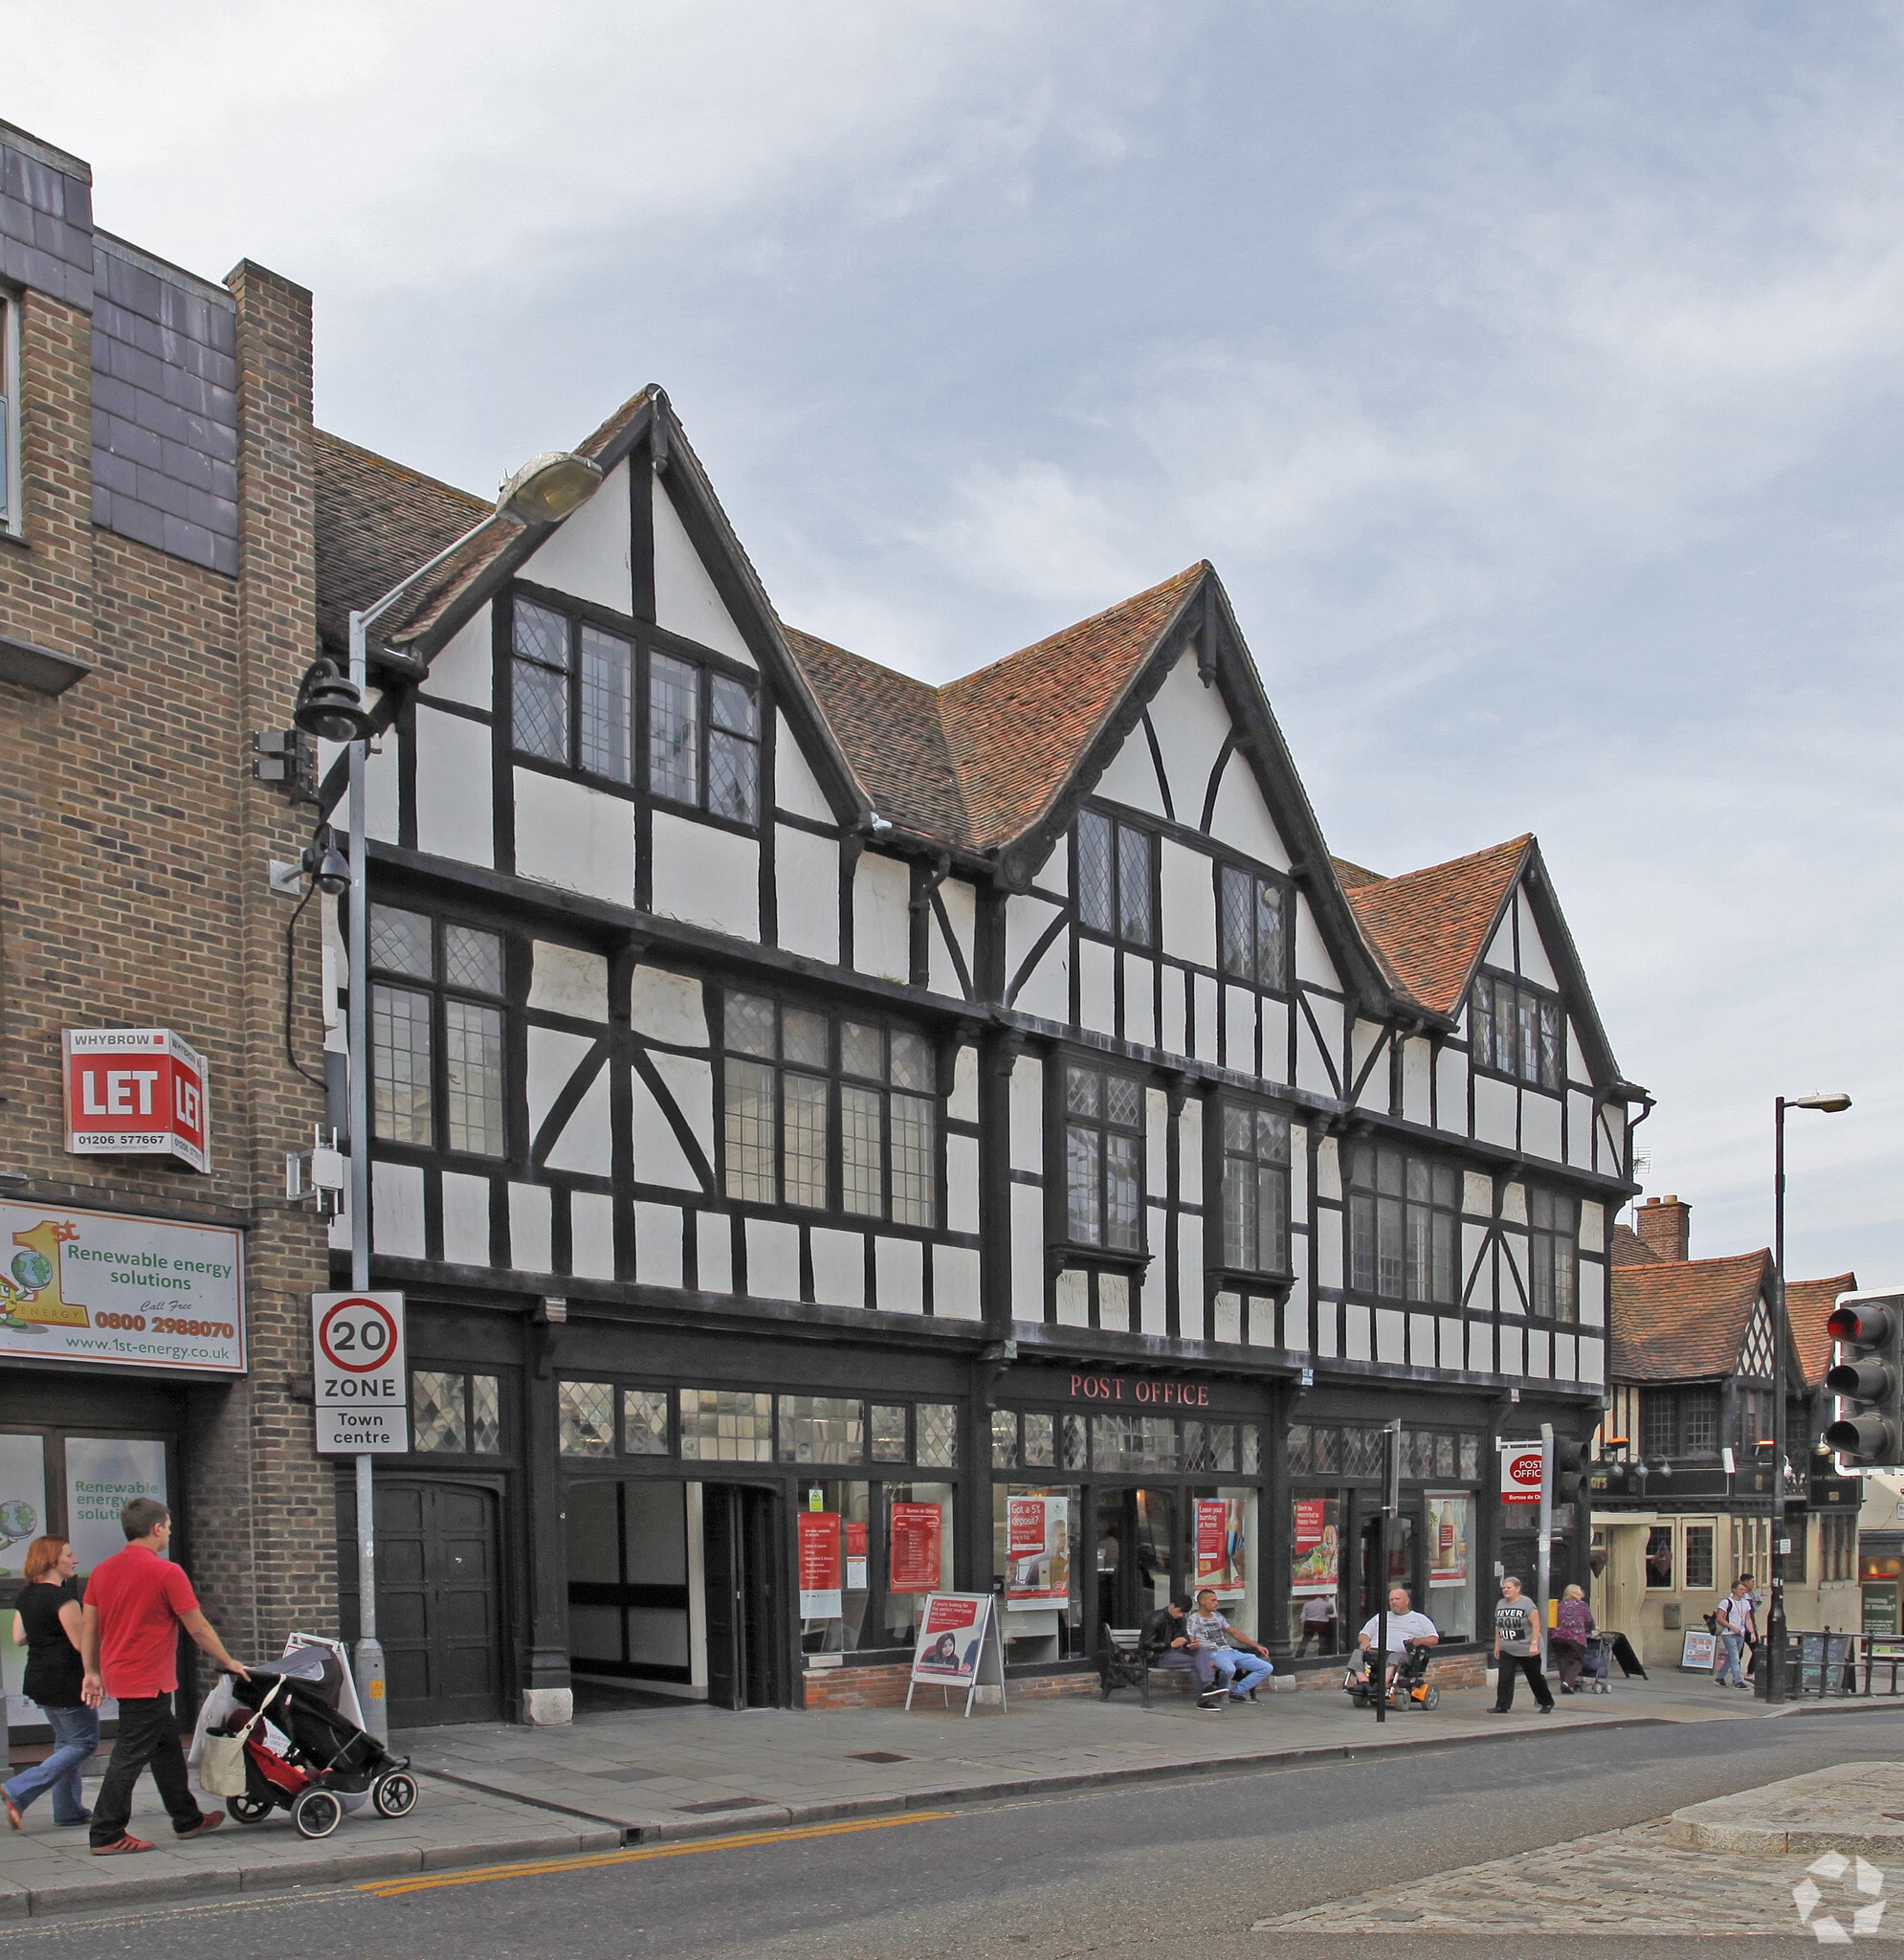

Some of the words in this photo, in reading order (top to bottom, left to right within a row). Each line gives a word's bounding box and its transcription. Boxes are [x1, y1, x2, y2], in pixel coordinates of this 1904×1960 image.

[75, 1035, 149, 1045] WHYBROW
[82, 1070, 158, 1115] LET
[175, 1075, 200, 1133] LET
[78, 1135, 115, 1145] 01206
[121, 1135, 165, 1145] 577667
[68, 1243, 167, 1269] Renewable
[173, 1258, 232, 1279] energy
[110, 1270, 191, 1290] solutions
[140, 1301, 166, 1312] Call
[167, 1300, 193, 1311] Free
[21, 1306, 79, 1320] ENERGY
[95, 1311, 146, 1331] 0800
[151, 1316, 234, 1339] 2988070
[332, 1321, 387, 1350] 20
[65, 1337, 230, 1360] www.1st-energy.co.uk
[324, 1378, 396, 1397] ZONE
[1071, 1374, 1124, 1400] POST
[1135, 1381, 1209, 1406] OFFICE
[338, 1413, 384, 1426] Town
[333, 1431, 390, 1444] centre
[1518, 1460, 1542, 1469] POST
[1513, 1469, 1541, 1478] OFFIC
[76, 1481, 159, 1494] Renewable
[77, 1494, 128, 1507] energy
[77, 1507, 122, 1520] soluti
[1011, 1503, 1024, 1514] Got
[1031, 1503, 1041, 1514] 5%
[1011, 1516, 1039, 1526] deposit?
[1498, 1617, 1521, 1629] ROW
